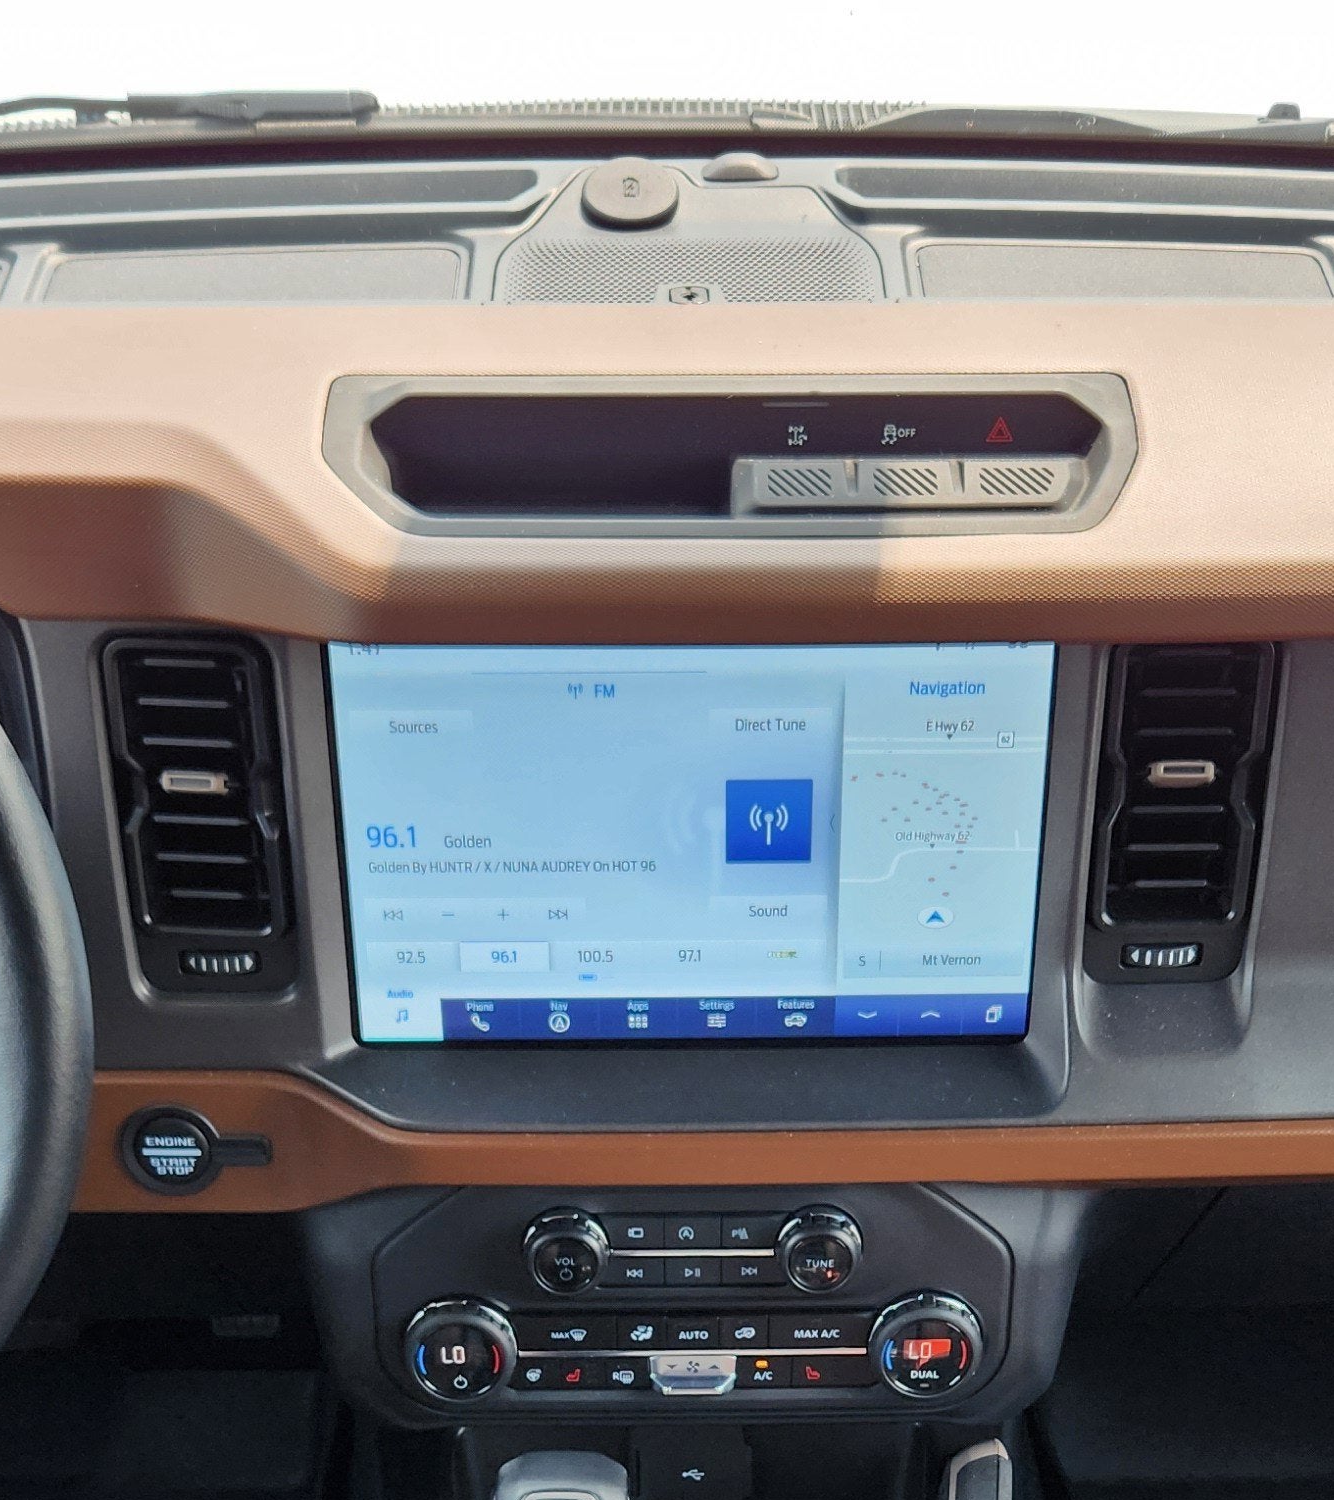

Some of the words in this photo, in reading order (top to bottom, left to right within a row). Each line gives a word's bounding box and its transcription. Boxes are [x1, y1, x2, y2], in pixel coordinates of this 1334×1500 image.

[898, 428, 917, 437] OFF
[594, 684, 615, 698] FM
[909, 681, 986, 697] Navigation
[389, 721, 438, 734] Sources
[735, 718, 772, 731] Direct
[776, 718, 806, 731] Tune
[926, 721, 933, 732] E
[935, 720, 958, 734] Hwy
[961, 720, 975, 732] 62
[367, 825, 417, 849] 96.1
[444, 835, 492, 849] Golden
[895, 832, 912, 841] Old
[914, 831, 955, 842] Highway
[368, 861, 410, 873] Golden
[412, 861, 427, 875] By
[429, 861, 472, 873] HUNTR
[484, 861, 492, 873] X
[503, 861, 538, 873] NUNA
[541, 861, 590, 873] AUDREY
[593, 861, 609, 873] On
[612, 861, 637, 872] HOT
[640, 861, 656, 872] 96
[749, 905, 788, 917] Sound
[396, 951, 426, 964] 92.5
[491, 950, 518, 964] 96.1
[578, 950, 614, 963] 100.5
[678, 950, 701, 963] 97.1
[858, 956, 866, 967] S
[922, 954, 938, 966] Mt
[940, 954, 981, 966] Vernon
[387, 989, 414, 999] Audio
[466, 1001, 494, 1012] Phone
[550, 1001, 568, 1011] Nav
[627, 1001, 649, 1012] Apps
[699, 1000, 735, 1012] Settings
[777, 999, 815, 1010] Features
[145, 1136, 196, 1147] ENGINE
[150, 1157, 197, 1168] START
[157, 1166, 194, 1176] STOP
[555, 1257, 575, 1267] VOL
[805, 1258, 835, 1269] TUNE
[550, 1331, 570, 1340] MAX
[678, 1330, 709, 1340] AUTO
[793, 1329, 819, 1339] MAX
[820, 1328, 840, 1340] A/C
[440, 1345, 466, 1365] LO
[753, 1370, 774, 1382] A/C
[910, 1370, 939, 1380] DUAL
